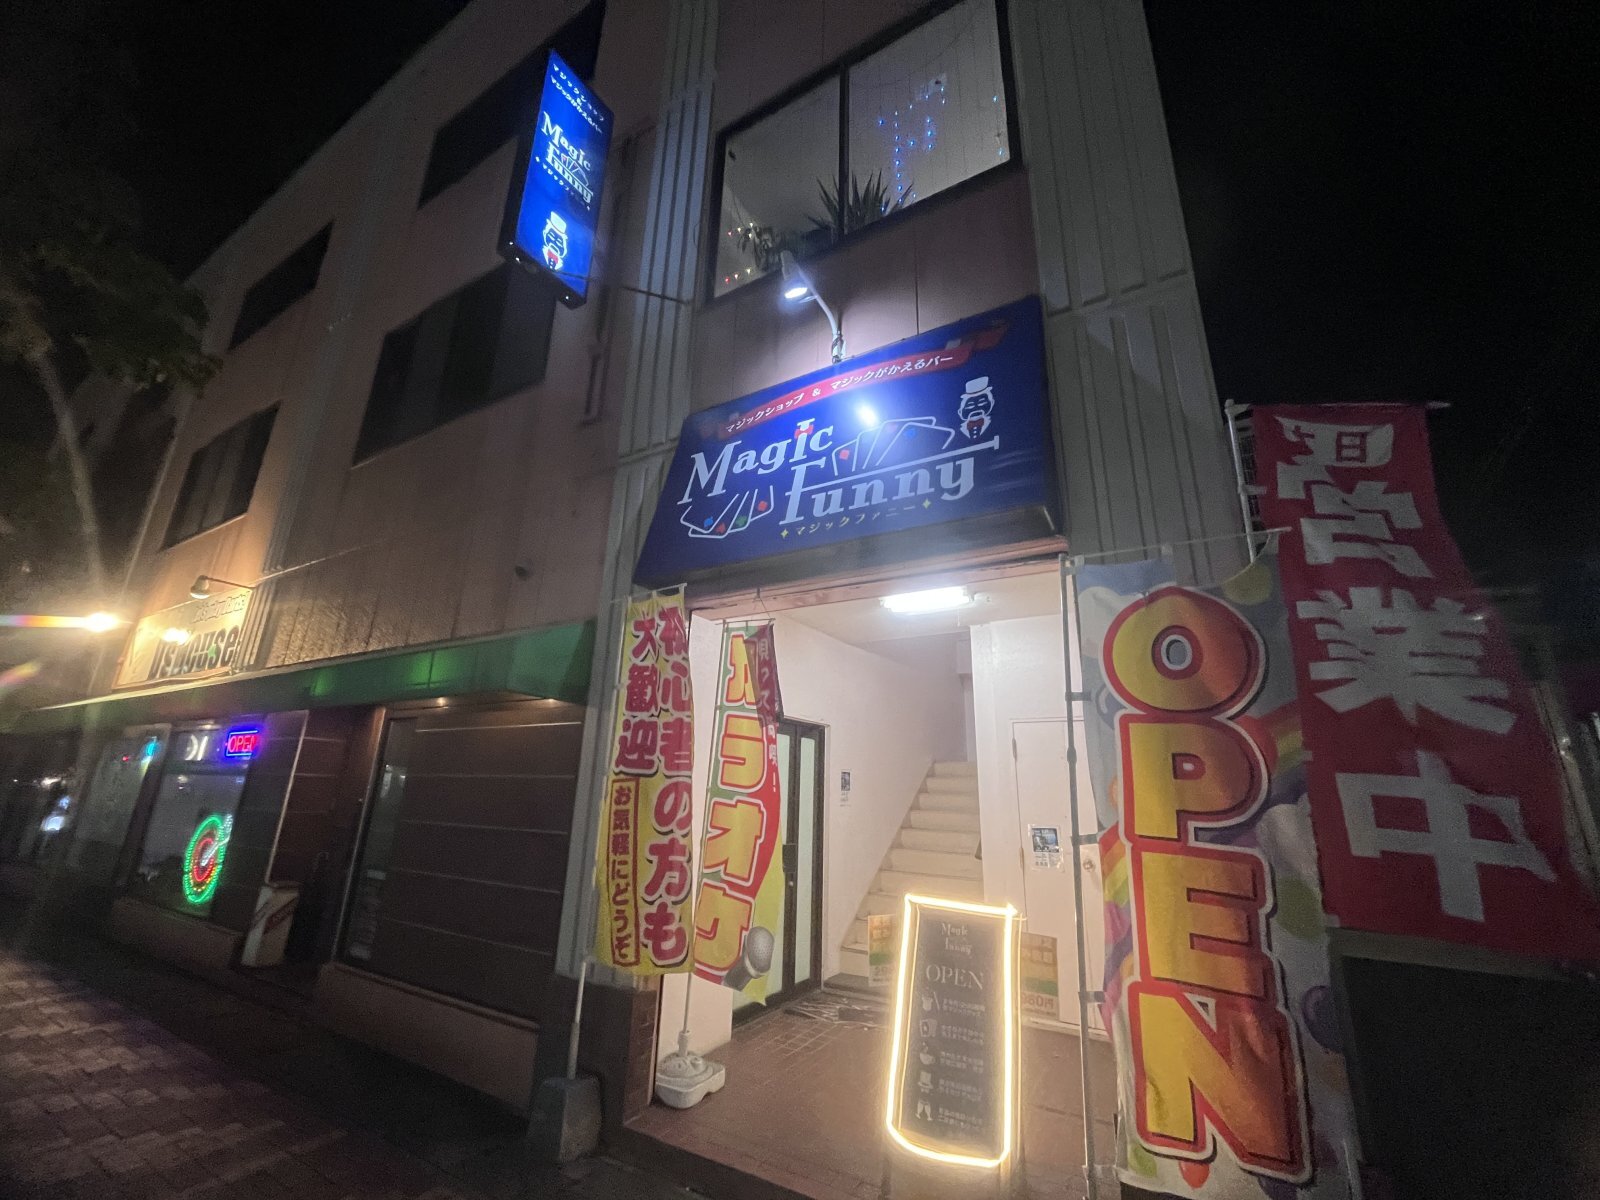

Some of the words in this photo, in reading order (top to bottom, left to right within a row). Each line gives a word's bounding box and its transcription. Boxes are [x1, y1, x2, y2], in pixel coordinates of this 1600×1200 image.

[540, 110, 591, 171] Magic
[545, 141, 594, 204] Funny
[725, 392, 805, 434] マジックショップ
[811, 388, 822, 398] &
[830, 356, 953, 391] マジックがかえるバー
[677, 417, 834, 506] Magic
[779, 437, 998, 526] Funny
[796, 504, 916, 536] マジックファニー
[613, 617, 659, 774] 大歓迎
[1102, 588, 1313, 1180] OPEN
[926, 964, 984, 990] OPEN
